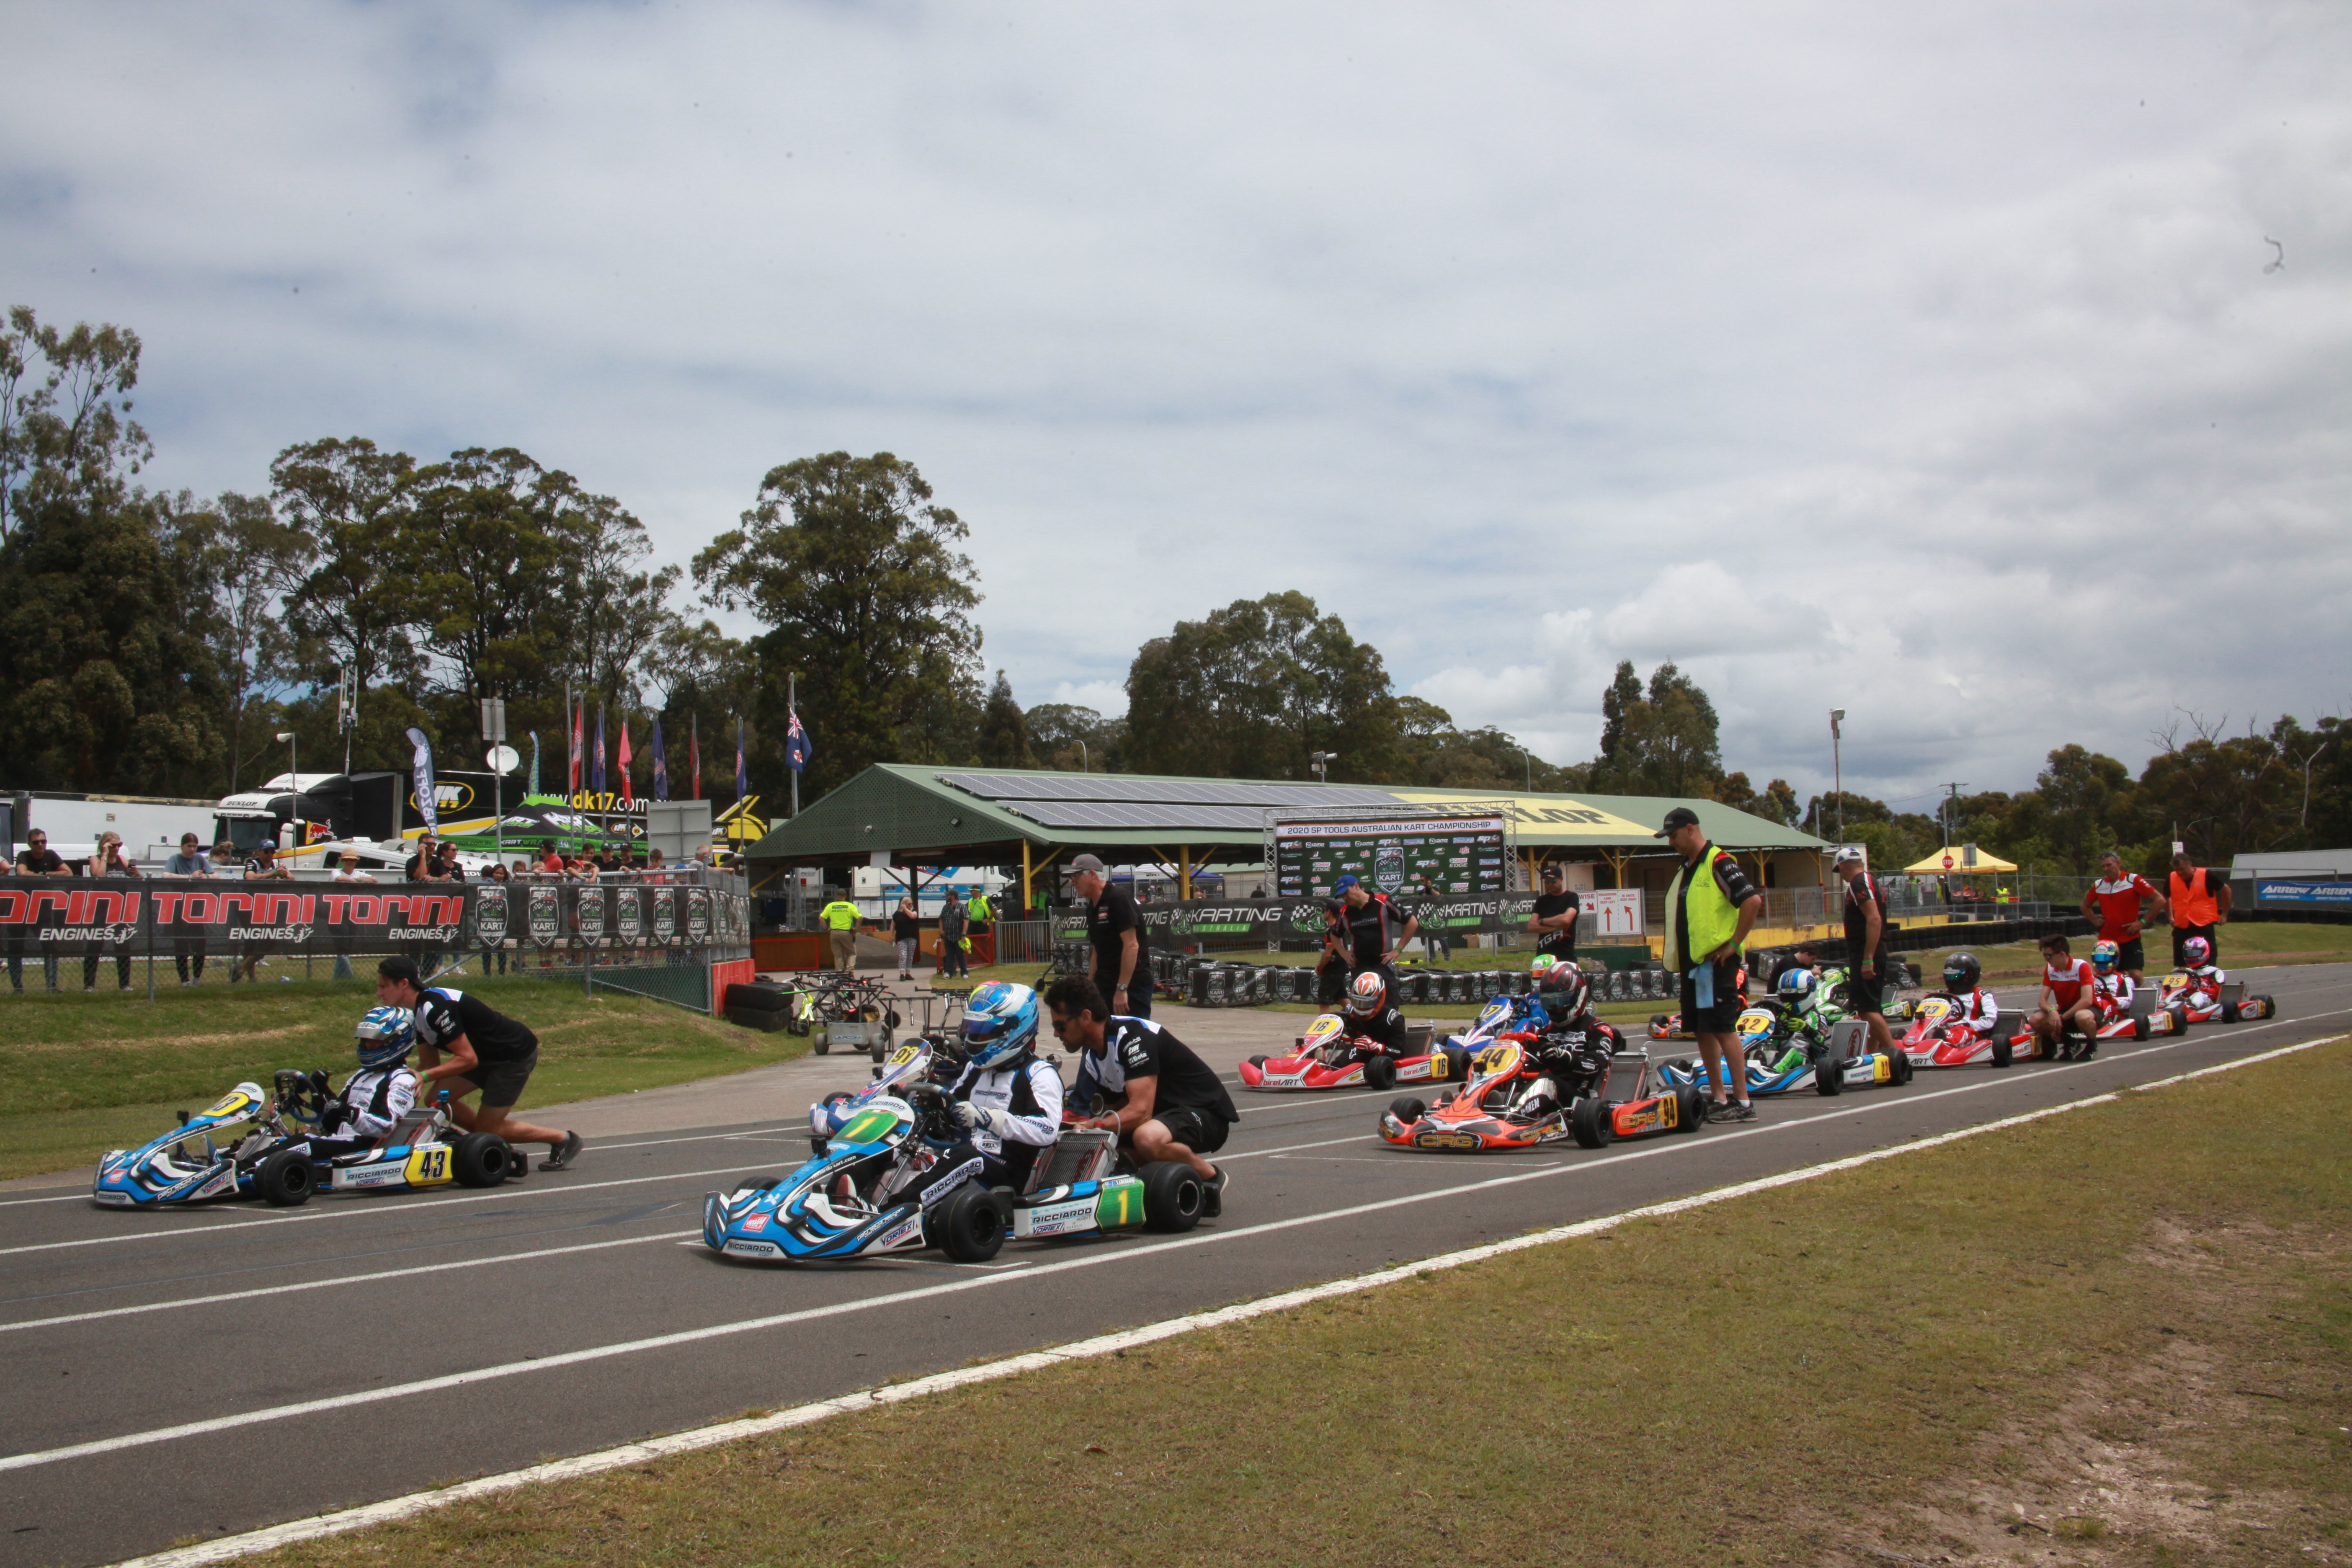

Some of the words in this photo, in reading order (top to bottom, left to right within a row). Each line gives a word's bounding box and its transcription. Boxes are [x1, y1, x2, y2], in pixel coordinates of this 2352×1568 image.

[1351, 824, 1402, 833] AUSTRALIAN
[1428, 821, 1491, 830] CHAMPIONSHIP
[2262, 885, 2311, 894] ARROW
[152, 892, 316, 923] TORINI
[322, 895, 464, 925] TORINI
[1191, 907, 1283, 922] KARTING
[1445, 902, 1496, 917] KARTING
[1064, 916, 1088, 928] KART
[39, 928, 115, 941] ENGINES
[229, 927, 294, 940] ENGINES
[389, 928, 443, 940] ENGINES
[1922, 1005, 1940, 1014] 33
[1312, 1021, 1330, 1032] 16
[892, 1046, 916, 1063] 91
[2013, 1044, 2031, 1055] birelART
[1132, 1052, 1148, 1062] Beta
[1482, 1049, 1507, 1067] 94
[1404, 1065, 1429, 1076] birelART
[1437, 1057, 1446, 1076] 16
[1850, 1070, 1872, 1078] RICCIARDO
[1881, 1060, 1889, 1076] 22
[1620, 1112, 1657, 1127] CRG
[1663, 1098, 1675, 1127] 94
[212, 1114, 240, 1127] Blastology
[844, 1116, 879, 1138] 1
[1520, 1123, 1562, 1141] CRG
[1420, 1135, 1473, 1147] CRG
[419, 1149, 447, 1180] 43
[347, 1168, 402, 1180] RICCIARDO
[926, 1161, 981, 1199] RICCIARDO
[202, 1173, 227, 1194] VORTEX
[356, 1177, 383, 1186] VORTEX
[1118, 1188, 1128, 1225] 1
[1032, 1207, 1092, 1225] RICCIARDO
[880, 1219, 913, 1247] VORTEX
[1032, 1222, 1063, 1235] VORTEX
[728, 1243, 774, 1252] RICCIARDO
